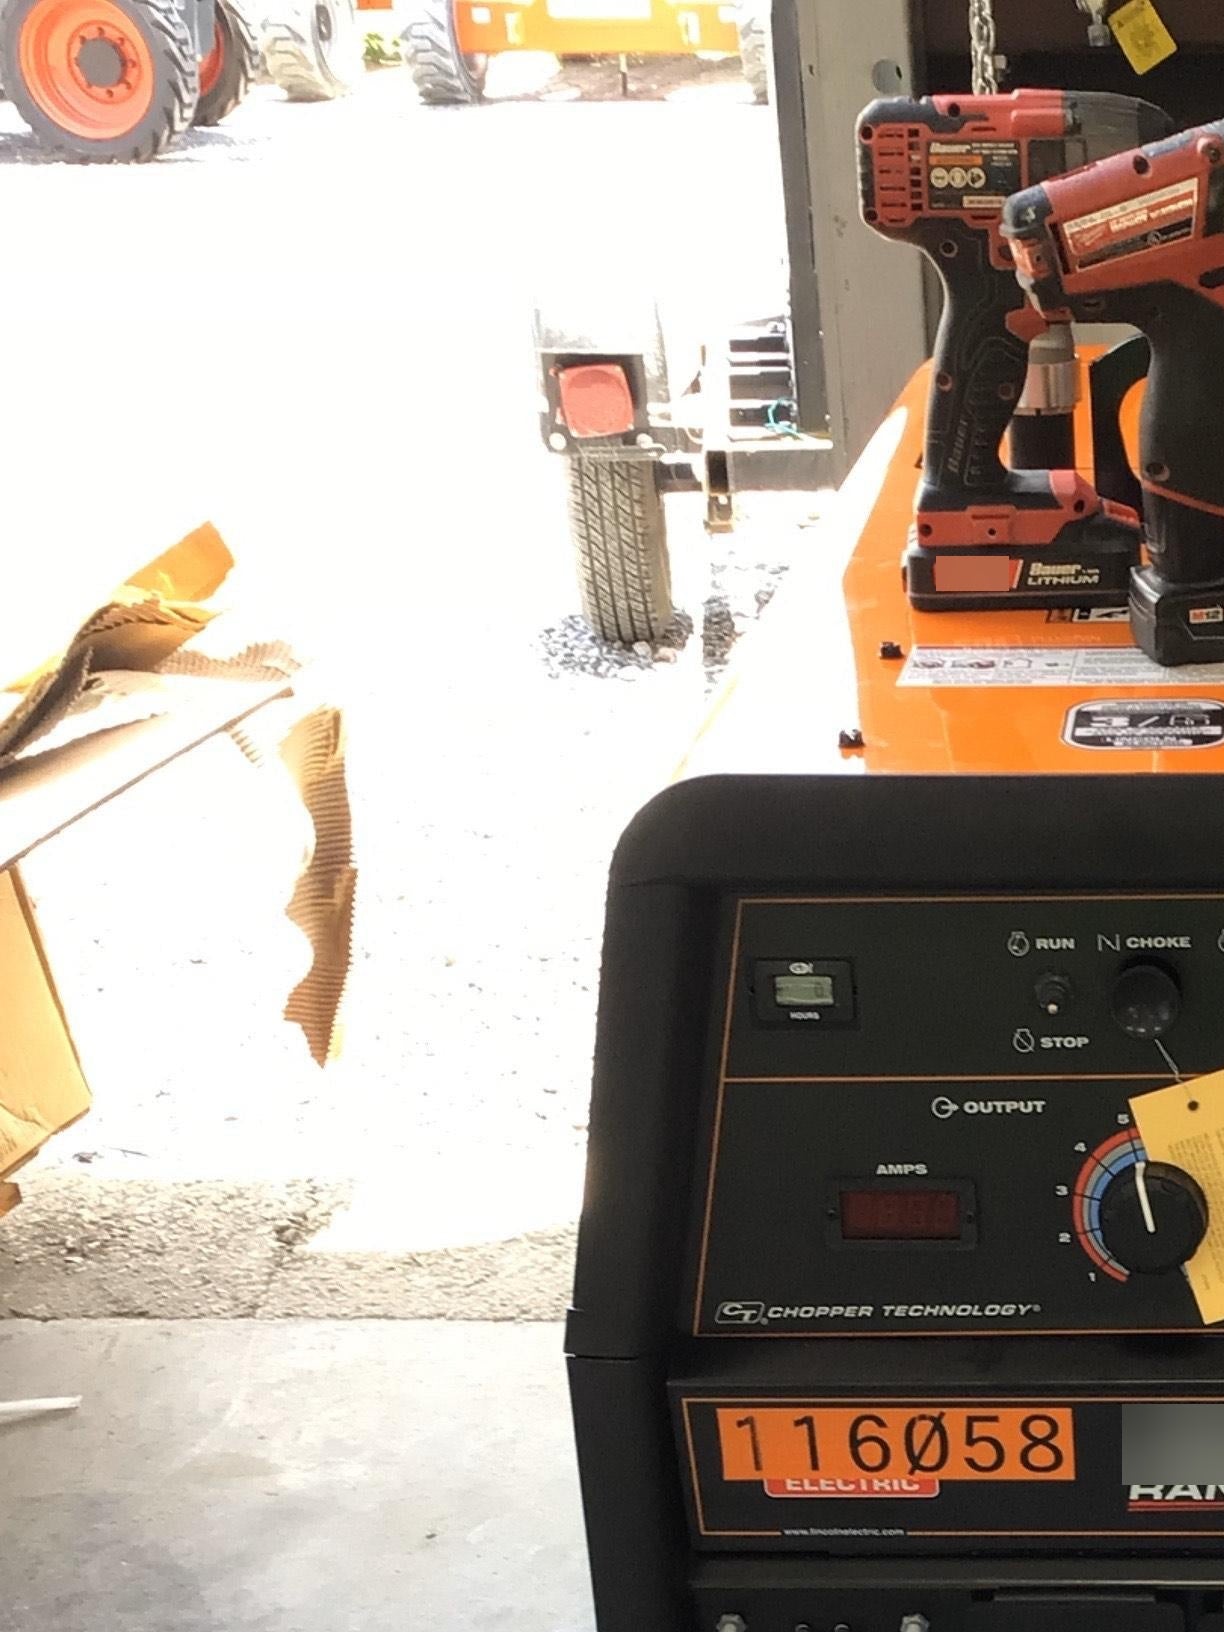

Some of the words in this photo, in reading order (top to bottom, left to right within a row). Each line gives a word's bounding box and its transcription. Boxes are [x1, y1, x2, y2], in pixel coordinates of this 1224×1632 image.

[1029, 562, 1082, 577] Bauer
[1027, 574, 1100, 586] LITHIUM
[1035, 937, 1076, 950] RUN
[1126, 935, 1192, 949] CHOKE
[1039, 1036, 1090, 1049] STOP
[963, 1101, 1046, 1114] OUTPUT
[1117, 1114, 1130, 1125] 5
[1073, 1142, 1088, 1153] 4
[876, 1164, 928, 1176] AMPS
[1055, 1185, 1069, 1196] 3
[1058, 1232, 1071, 1244] 2
[1088, 1272, 1096, 1283] 1
[766, 1305, 874, 1319] CHOPPER
[785, 1478, 920, 1492] ELECTRIC
